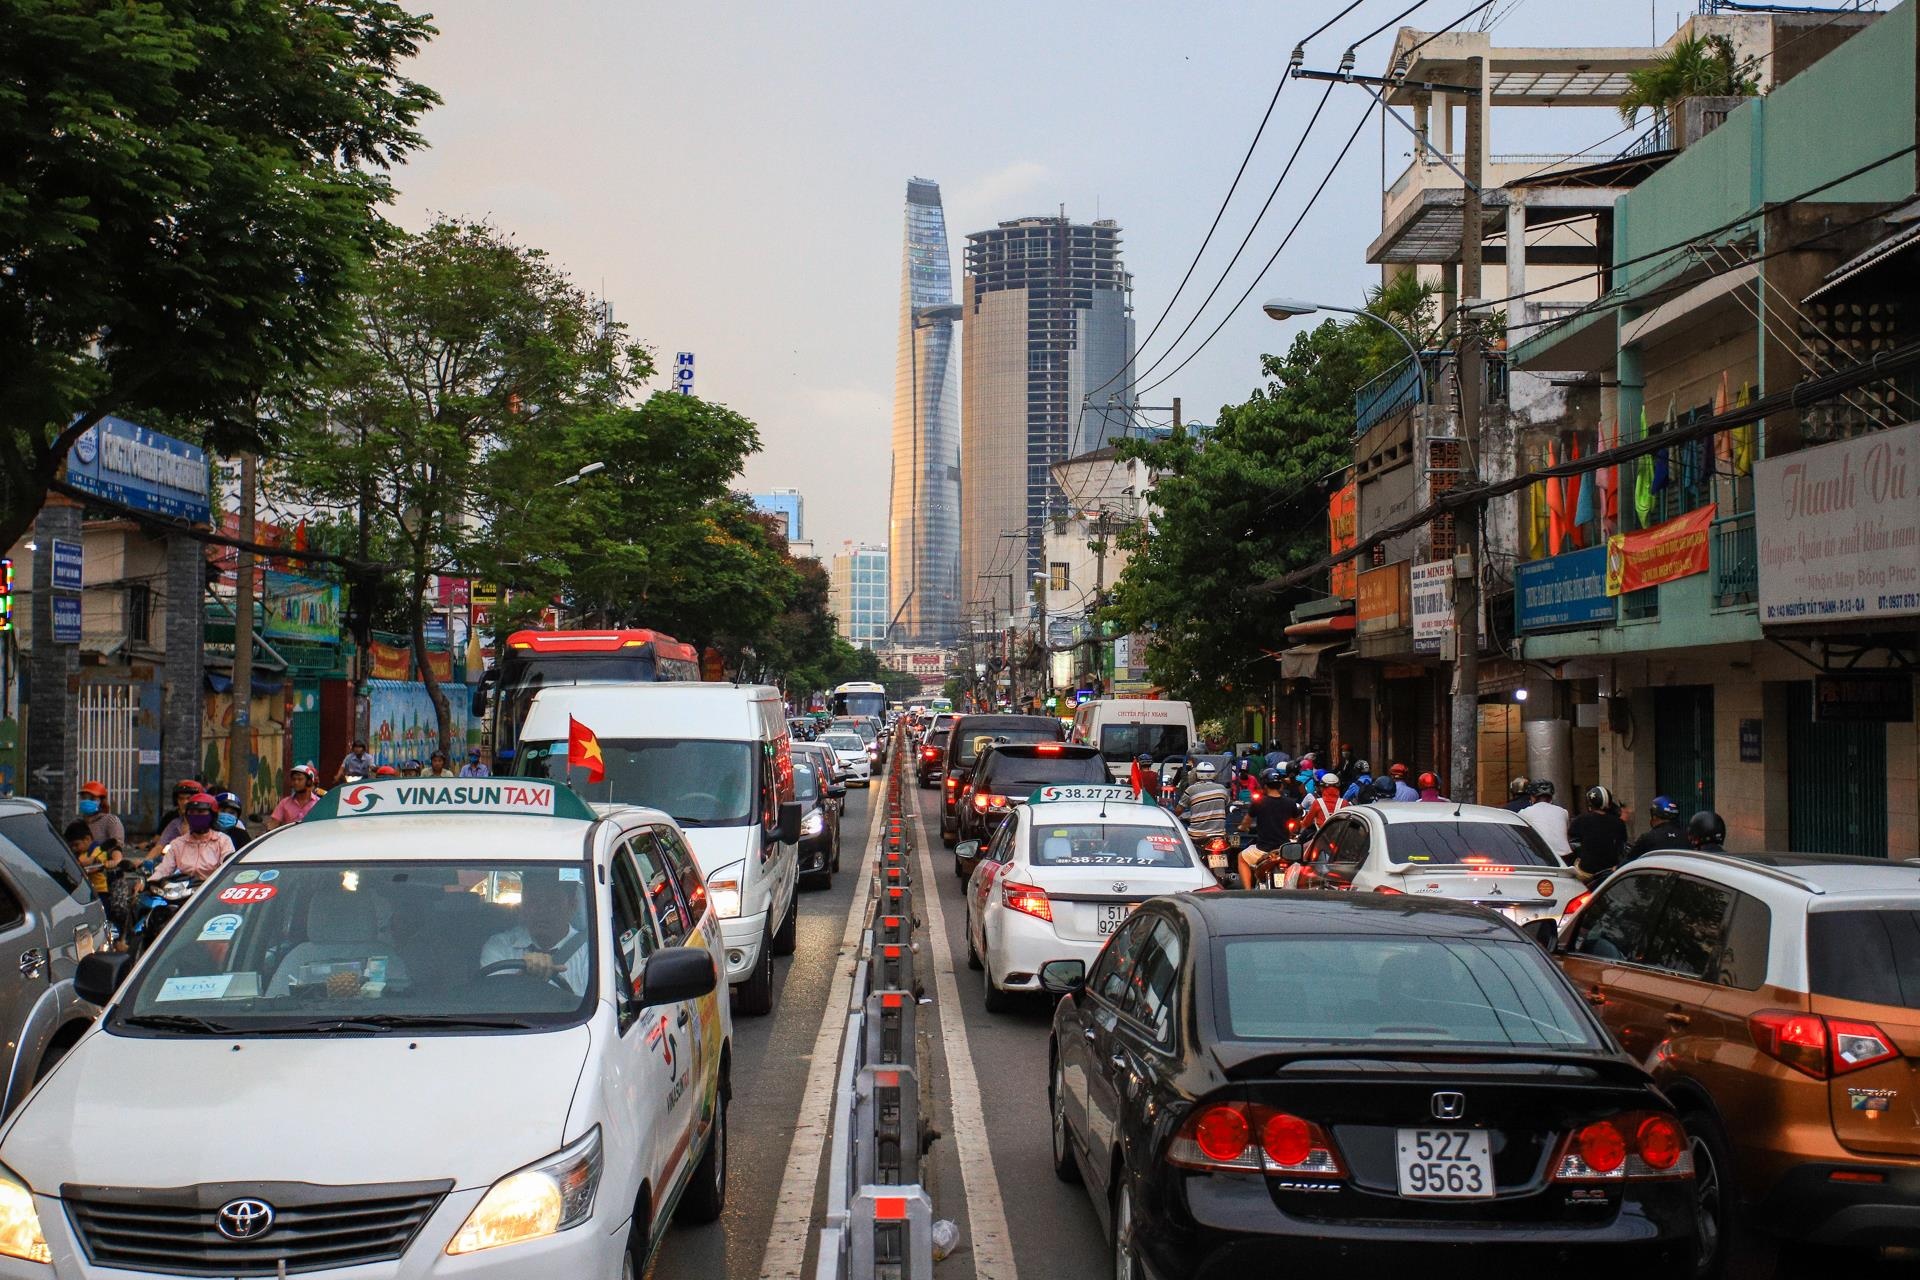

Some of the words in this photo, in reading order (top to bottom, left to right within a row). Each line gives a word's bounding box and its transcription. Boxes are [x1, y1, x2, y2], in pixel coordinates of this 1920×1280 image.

[1781, 452, 1857, 521] Thanh
[396, 786, 501, 805] VINASUN
[503, 786, 550, 807] TAXI
[1065, 788, 1102, 799] 38.27
[1105, 789, 1121, 799] 27
[1116, 856, 1134, 864] 27
[220, 887, 273, 900] 8613
[1416, 1130, 1472, 1163] 52Z
[1410, 1163, 1484, 1194] 9563
